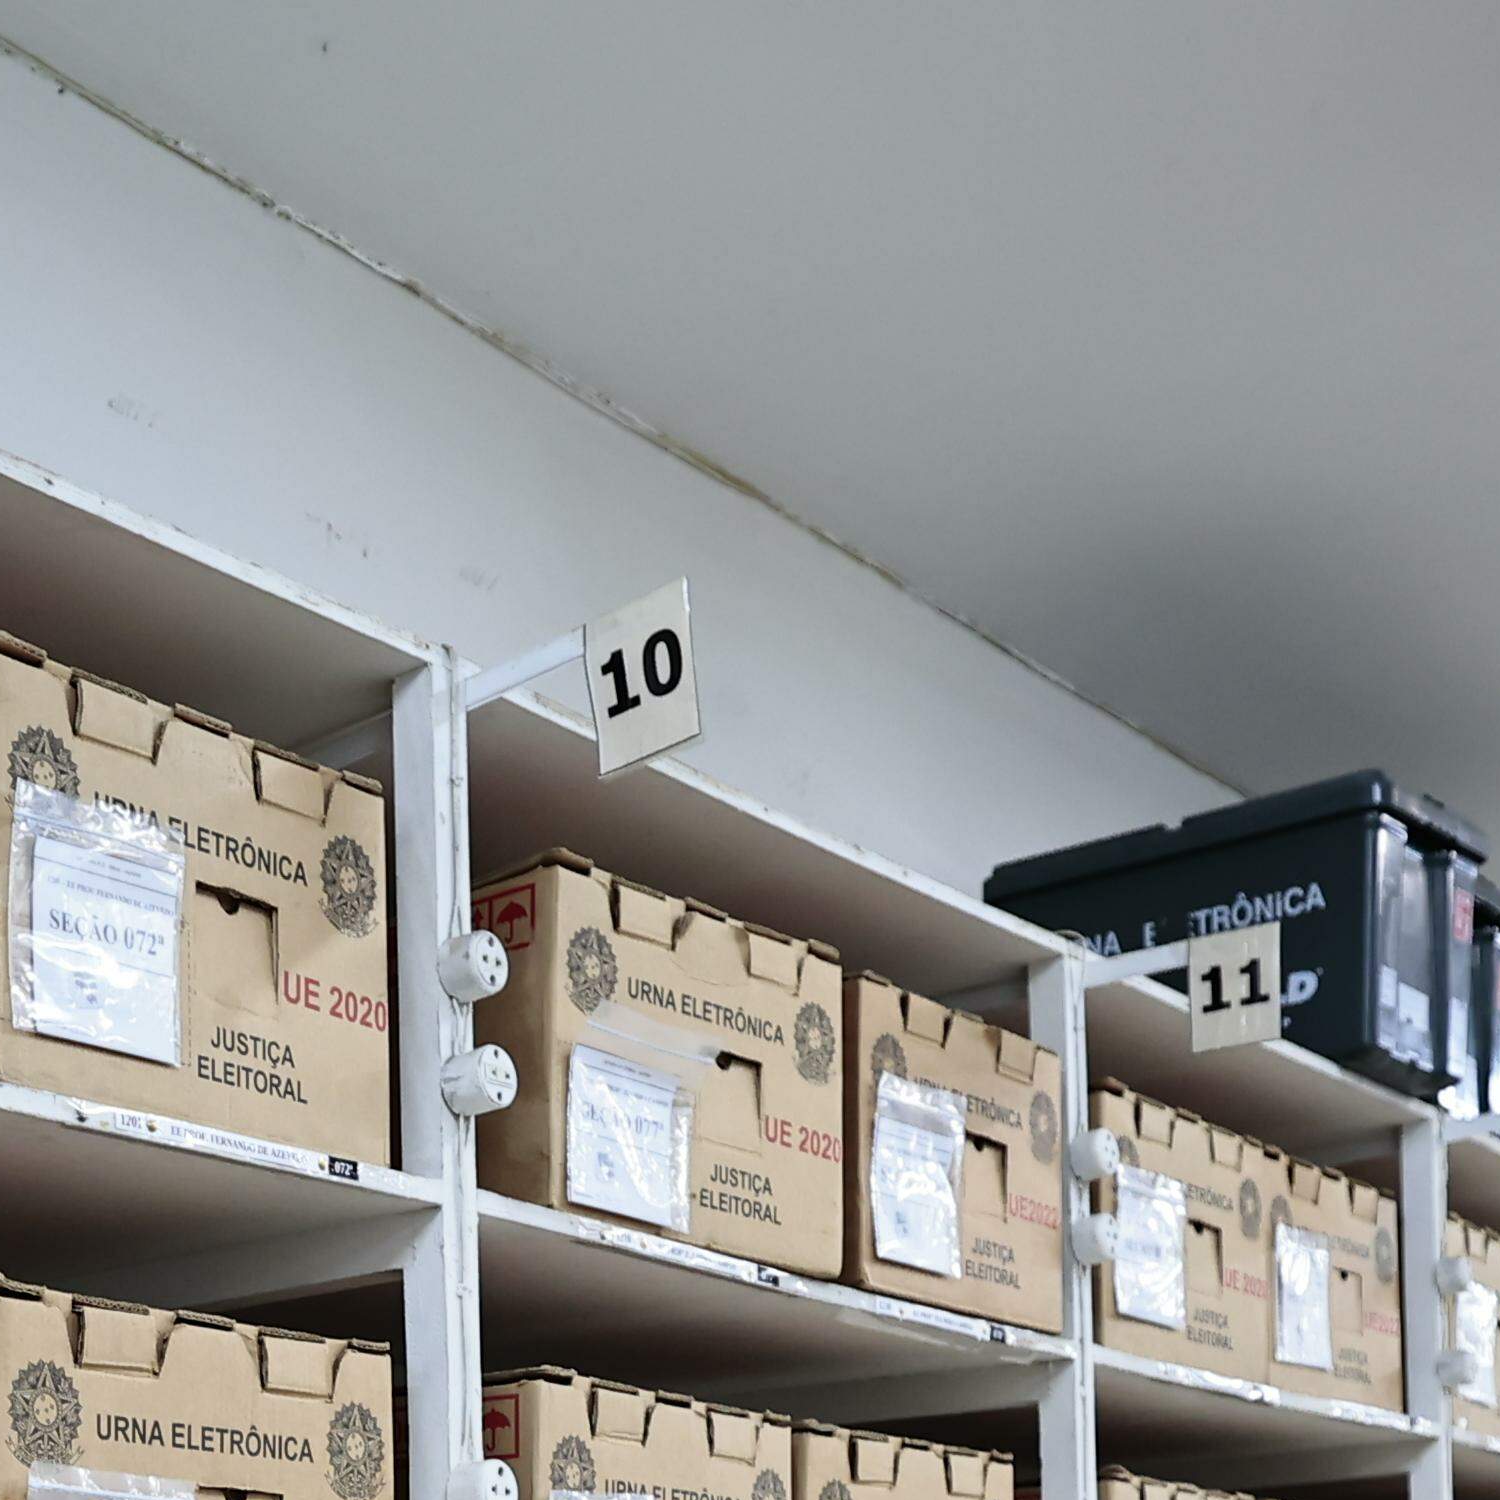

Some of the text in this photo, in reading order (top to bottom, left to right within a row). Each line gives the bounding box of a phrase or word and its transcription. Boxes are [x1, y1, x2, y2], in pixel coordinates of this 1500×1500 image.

[601, 629, 683, 719] 10
[283, 969, 388, 1033] UE 2020
[1201, 956, 1271, 1014] 11
[626, 976, 785, 1046] URNA ELETRÔNICA
[210, 1024, 296, 1070] JUSTIÇA
[197, 1055, 309, 1106] ELEITORAL
[764, 1113, 793, 1148] UE
[709, 1163, 773, 1198] JUSTIÇA
[699, 1190, 782, 1226] ELEITORAL
[96, 1413, 315, 1463] URNA ELETRÔNICA
